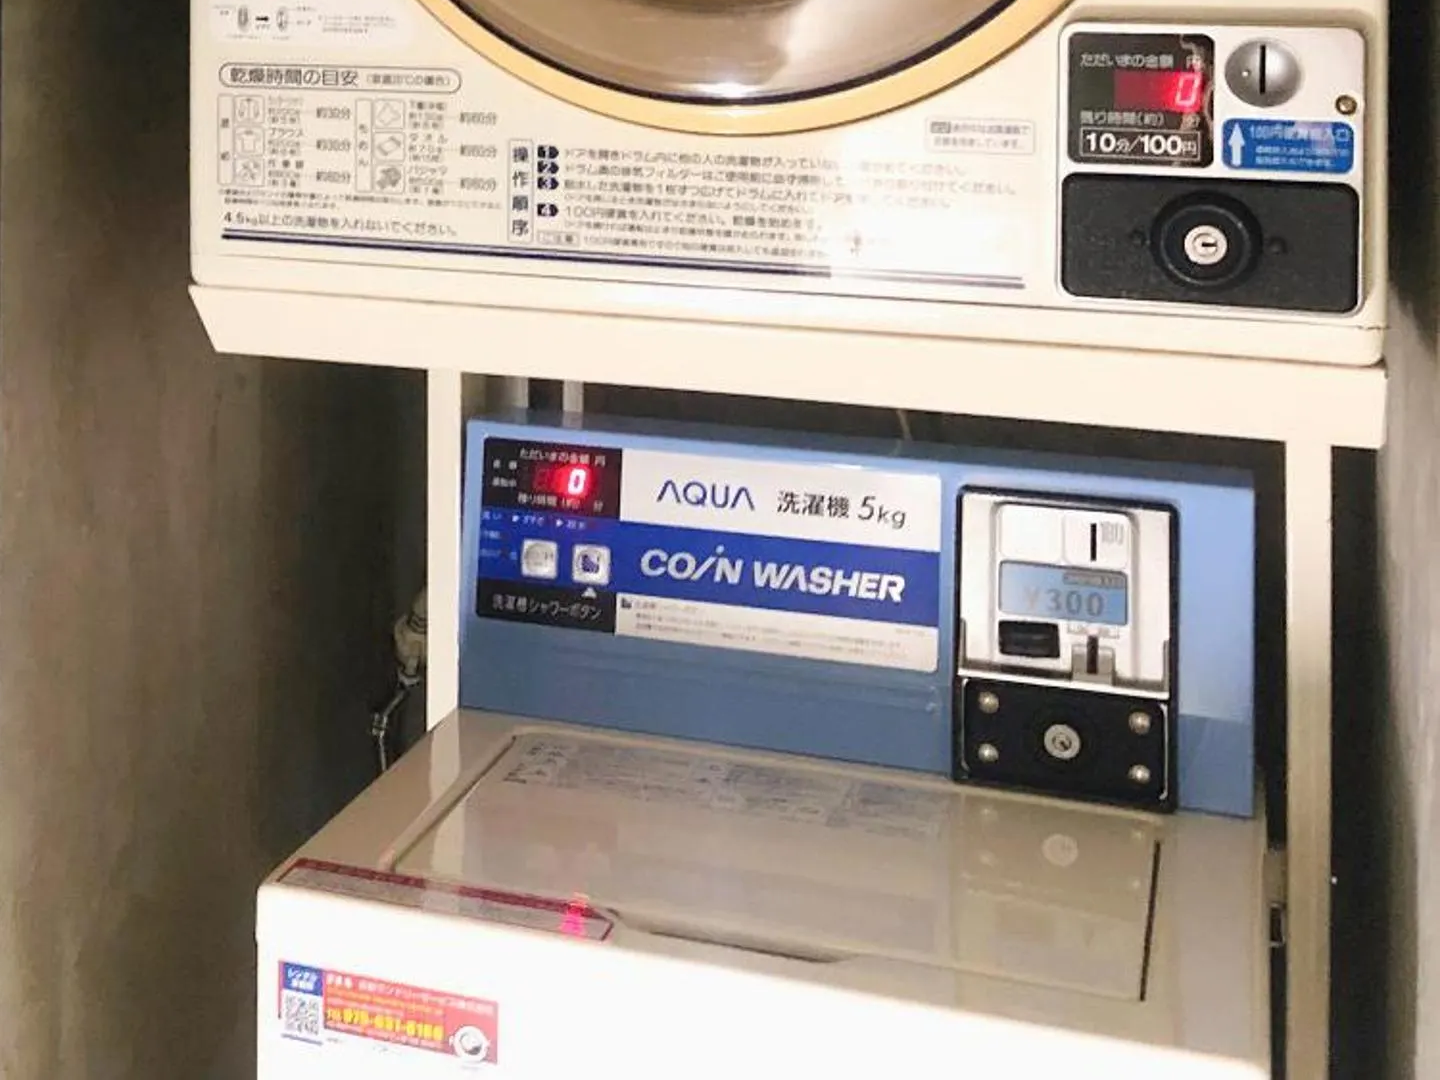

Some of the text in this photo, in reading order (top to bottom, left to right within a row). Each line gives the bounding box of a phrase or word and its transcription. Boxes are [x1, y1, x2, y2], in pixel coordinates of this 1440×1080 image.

[1079, 53, 1202, 69] ただいまの金額 円
[230, 68, 359, 87] 乾燥時間の目安
[1174, 72, 1202, 108] 0
[1085, 132, 1198, 156] 10分/100円
[519, 447, 591, 465] ただいまの金額
[594, 455, 607, 468] 円
[567, 467, 588, 496] 0
[656, 479, 756, 512] AQUA
[776, 490, 908, 530] 洗濯機 5kg
[752, 559, 906, 604] WASHER
